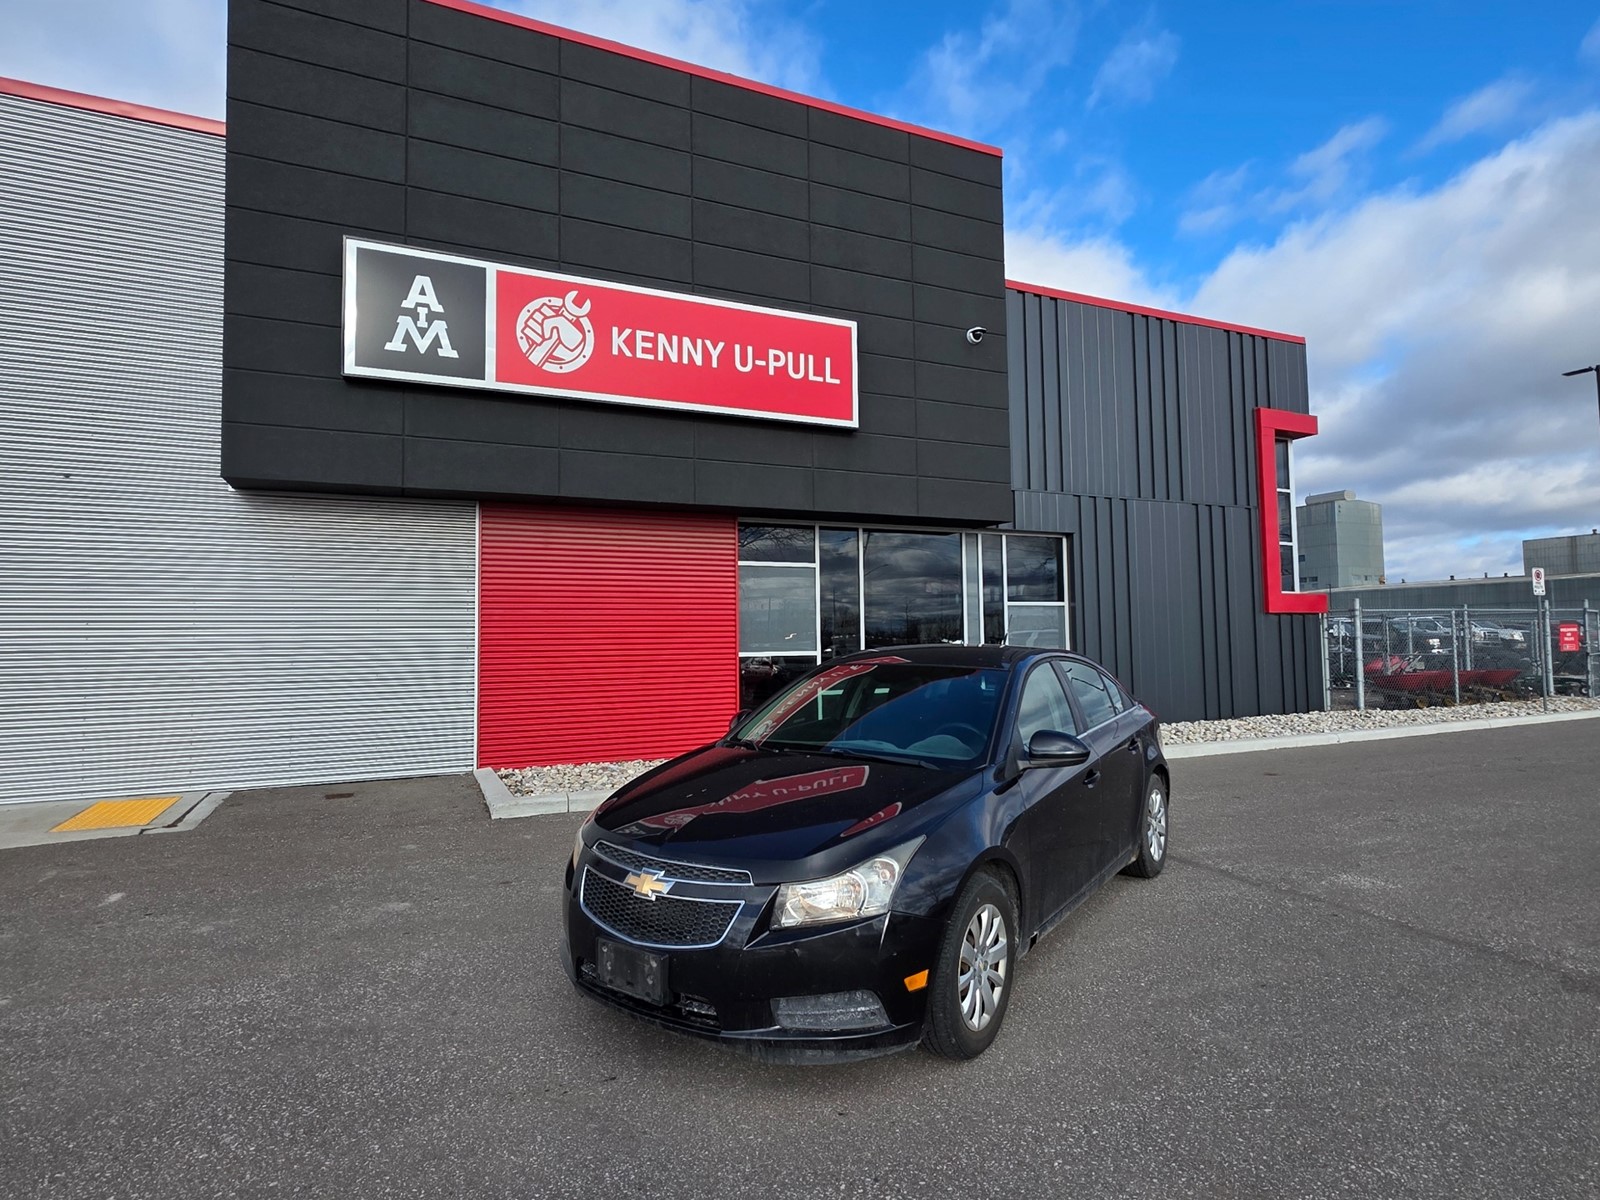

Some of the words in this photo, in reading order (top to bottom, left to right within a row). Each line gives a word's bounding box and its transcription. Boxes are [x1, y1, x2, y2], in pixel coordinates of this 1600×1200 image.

[384, 275, 459, 358] AIM
[611, 326, 725, 369] KENNY
[734, 344, 841, 385] U-PULL
